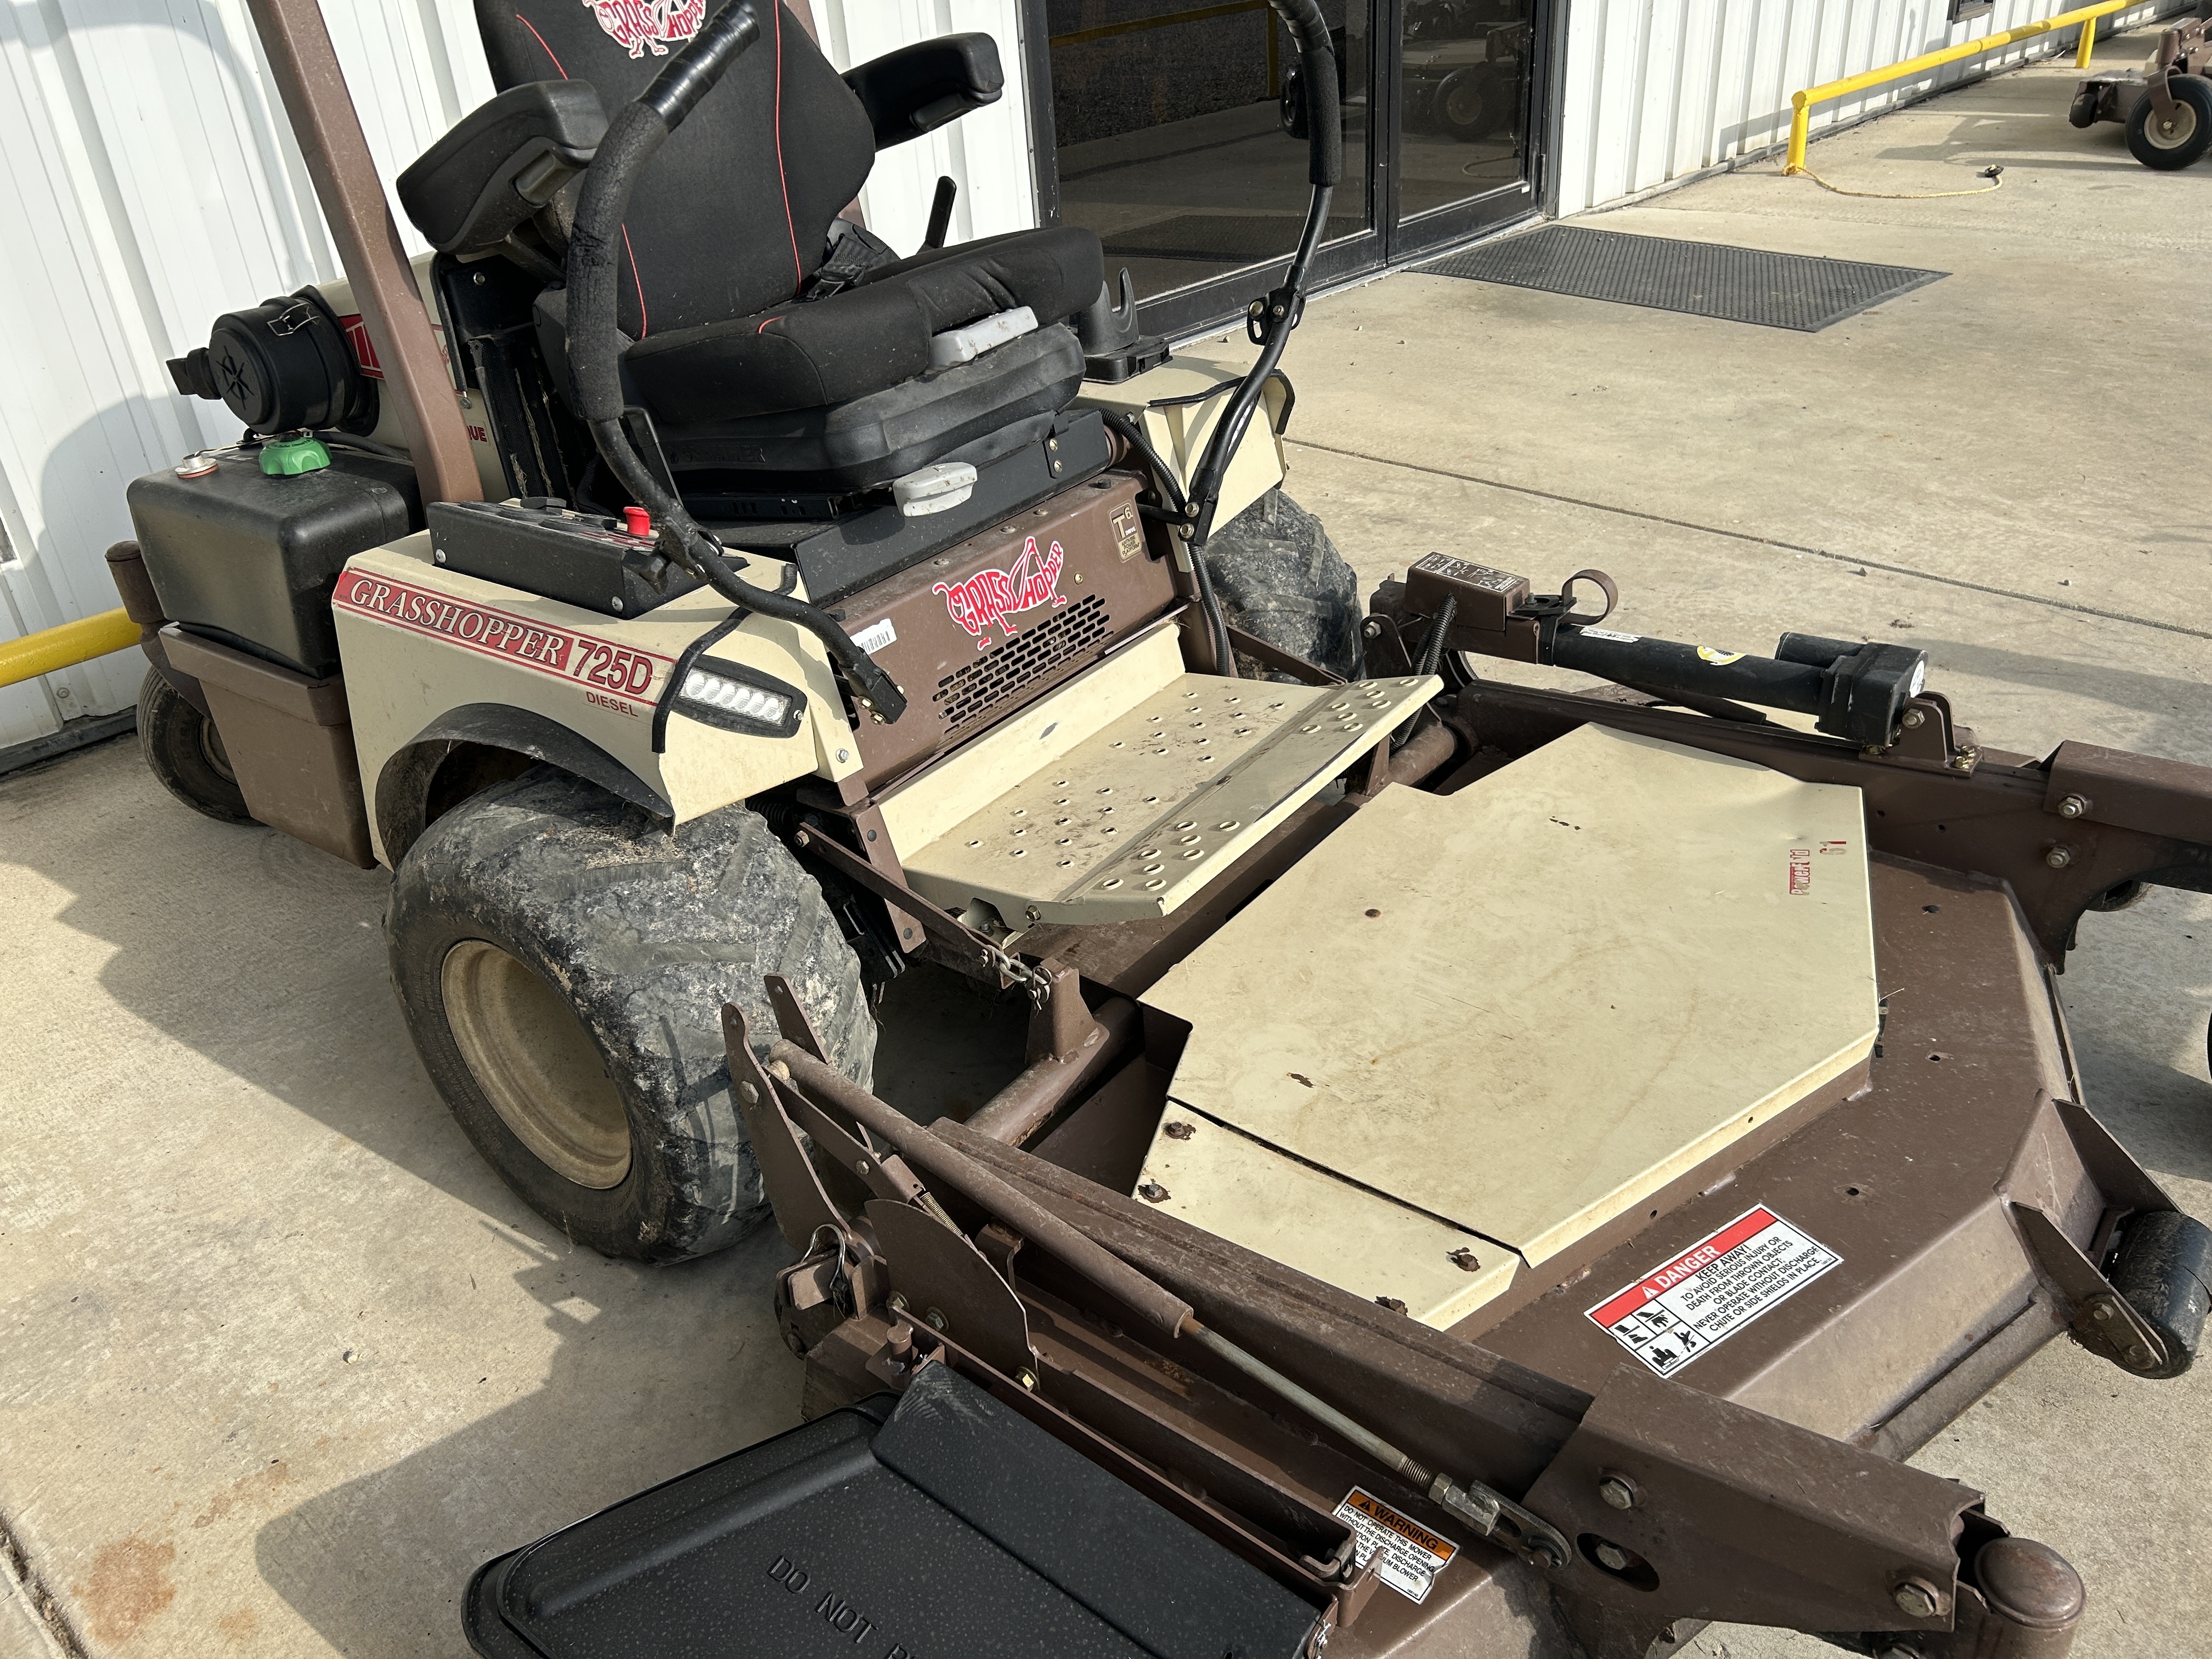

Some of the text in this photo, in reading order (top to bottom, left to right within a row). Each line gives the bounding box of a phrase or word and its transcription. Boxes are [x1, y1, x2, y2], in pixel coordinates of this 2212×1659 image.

[1125, 526, 1136, 535] DRIVE
[351, 579, 653, 695] GRASSHOPPER 725D
[586, 691, 639, 718] DIESEL
[431, 1013, 441, 1029] ONLY
[437, 1031, 447, 1044] USE
[427, 1032, 449, 1068] SERVICE
[444, 1047, 458, 1070] INJURY
[447, 1073, 475, 1111] HIGHWAY
[457, 1073, 476, 1100] SERIOUS
[1654, 1244, 1720, 1288] DANGER
[1680, 1235, 1782, 1301] TO AVOID SERIOUS INJURY OR
[1685, 1240, 1793, 1310] DEATH FROM THROWN OBJECTS
[1695, 1244, 1751, 1281] KEEP AWAY!
[1693, 1246, 1819, 1329] NEVER OPERATE WITHOUT DISCHARGE
[1709, 1313, 1735, 1331] CHUTE
[1732, 1305, 1747, 1316] OR
[1743, 1294, 1763, 1308] SIDE
[1760, 1277, 1790, 1297] SHIELDS
[1786, 1271, 1798, 1280] IN
[1795, 1257, 1822, 1274] PLACE.
[1713, 1294, 1727, 1305] OR
[1724, 1279, 1750, 1297] BLADE
[1339, 1512, 1435, 1572] WITHOUT THE DISCHARGE OPENING
[1344, 1505, 1431, 1561] DO NOT OPERATE THIS MOWER
[1374, 1505, 1439, 1551] WARNING
[1358, 1542, 1370, 1552] THE
[1392, 1563, 1418, 1582] BLOWER
[1391, 1553, 1426, 1577] DISCHARGE
[767, 1555, 878, 1644] DO NOT
